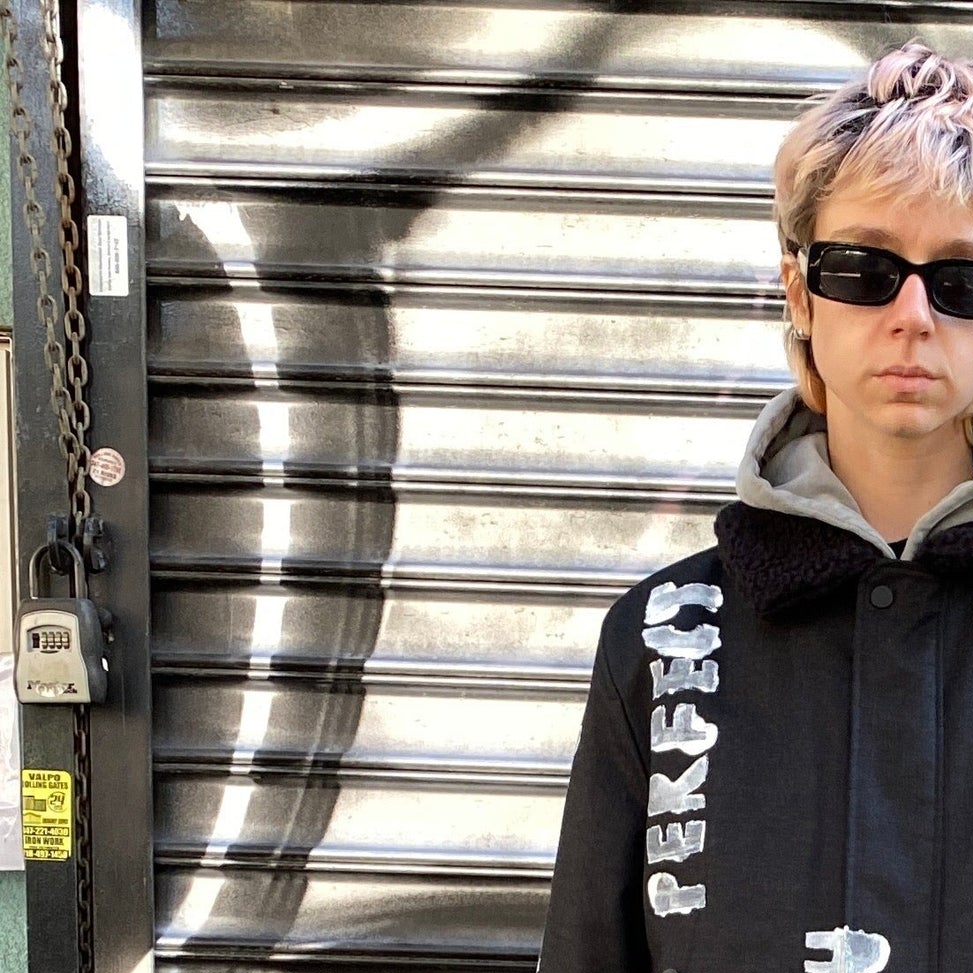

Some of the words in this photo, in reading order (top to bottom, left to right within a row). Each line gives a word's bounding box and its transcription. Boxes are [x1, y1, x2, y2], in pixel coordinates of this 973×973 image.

[641, 582, 723, 918] PERFECT
[29, 773, 61, 781] VALPO
[24, 781, 47, 789] OLLING
[48, 781, 68, 790] GATES
[24, 835, 41, 845] IRON
[42, 837, 64, 846] WORK
